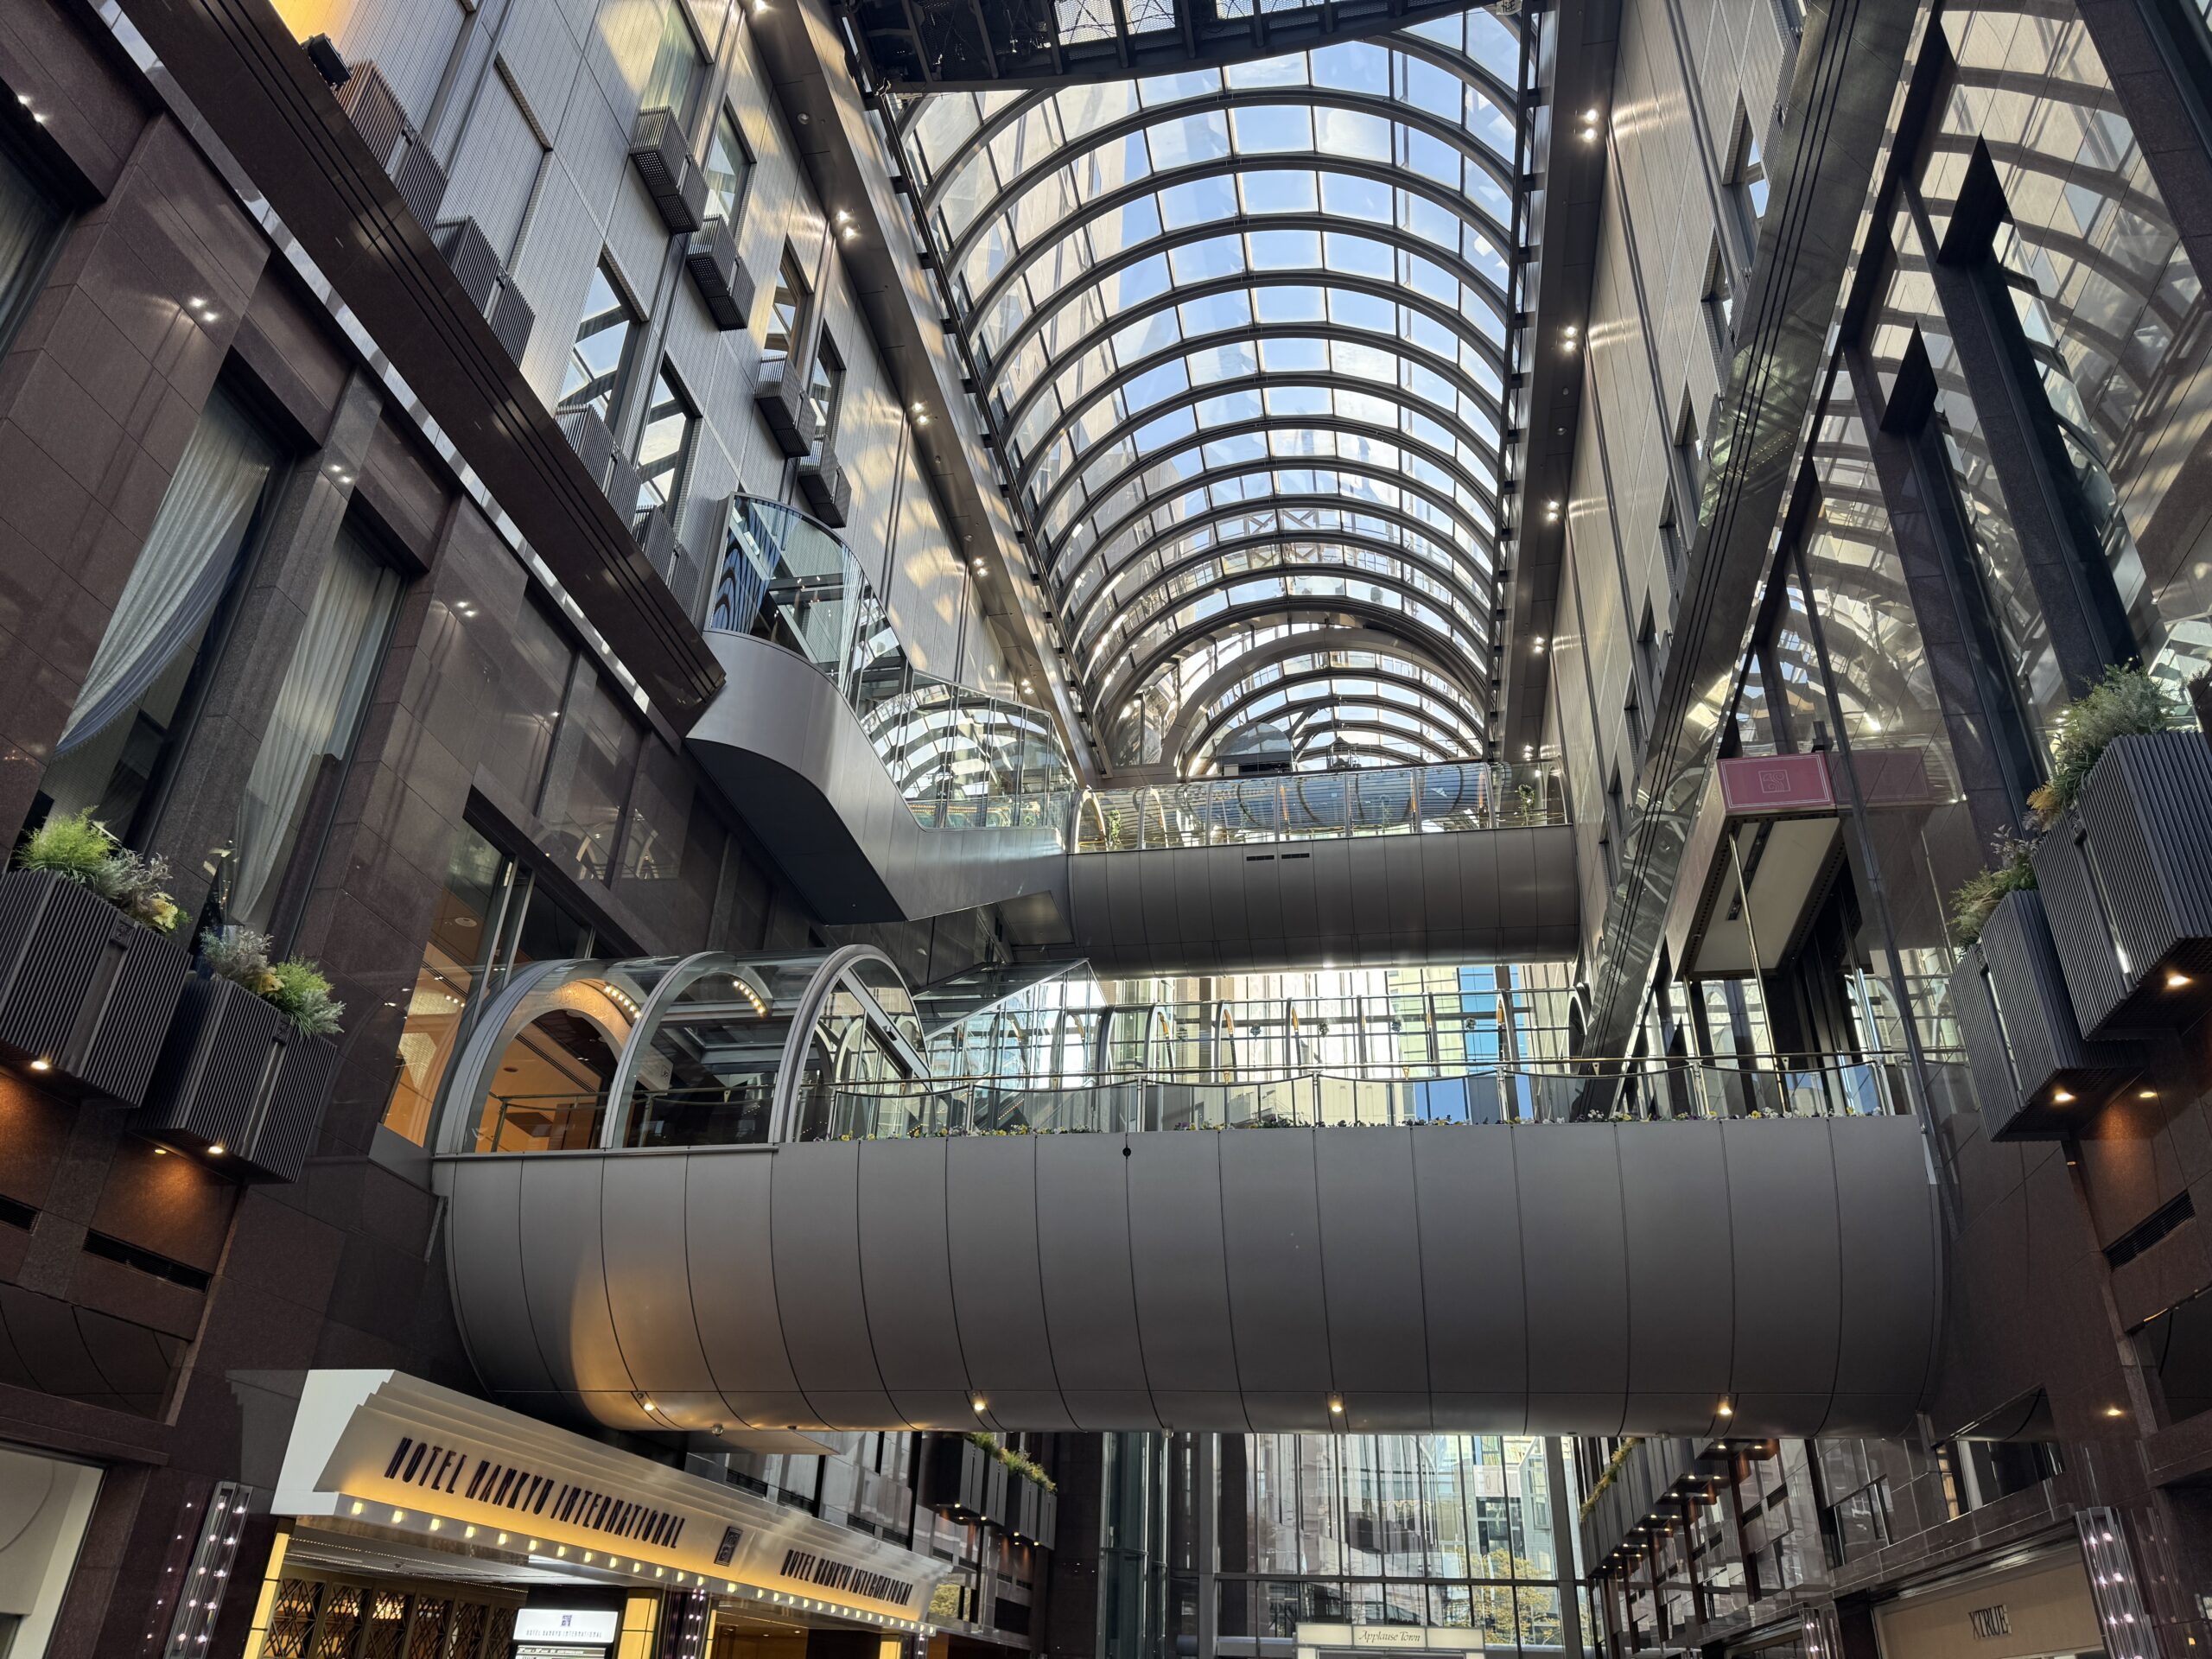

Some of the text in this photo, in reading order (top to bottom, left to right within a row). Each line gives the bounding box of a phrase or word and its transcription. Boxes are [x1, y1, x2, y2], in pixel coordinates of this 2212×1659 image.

[385, 1437, 685, 1548] HOTEL HANKYU INTERNATIONAL
[780, 1549, 913, 1606] HOTEL HANKYU INTERNATIONAL
[1358, 1630, 1421, 1643] Applause Town
[1968, 1605, 2009, 1640] XTRUE
